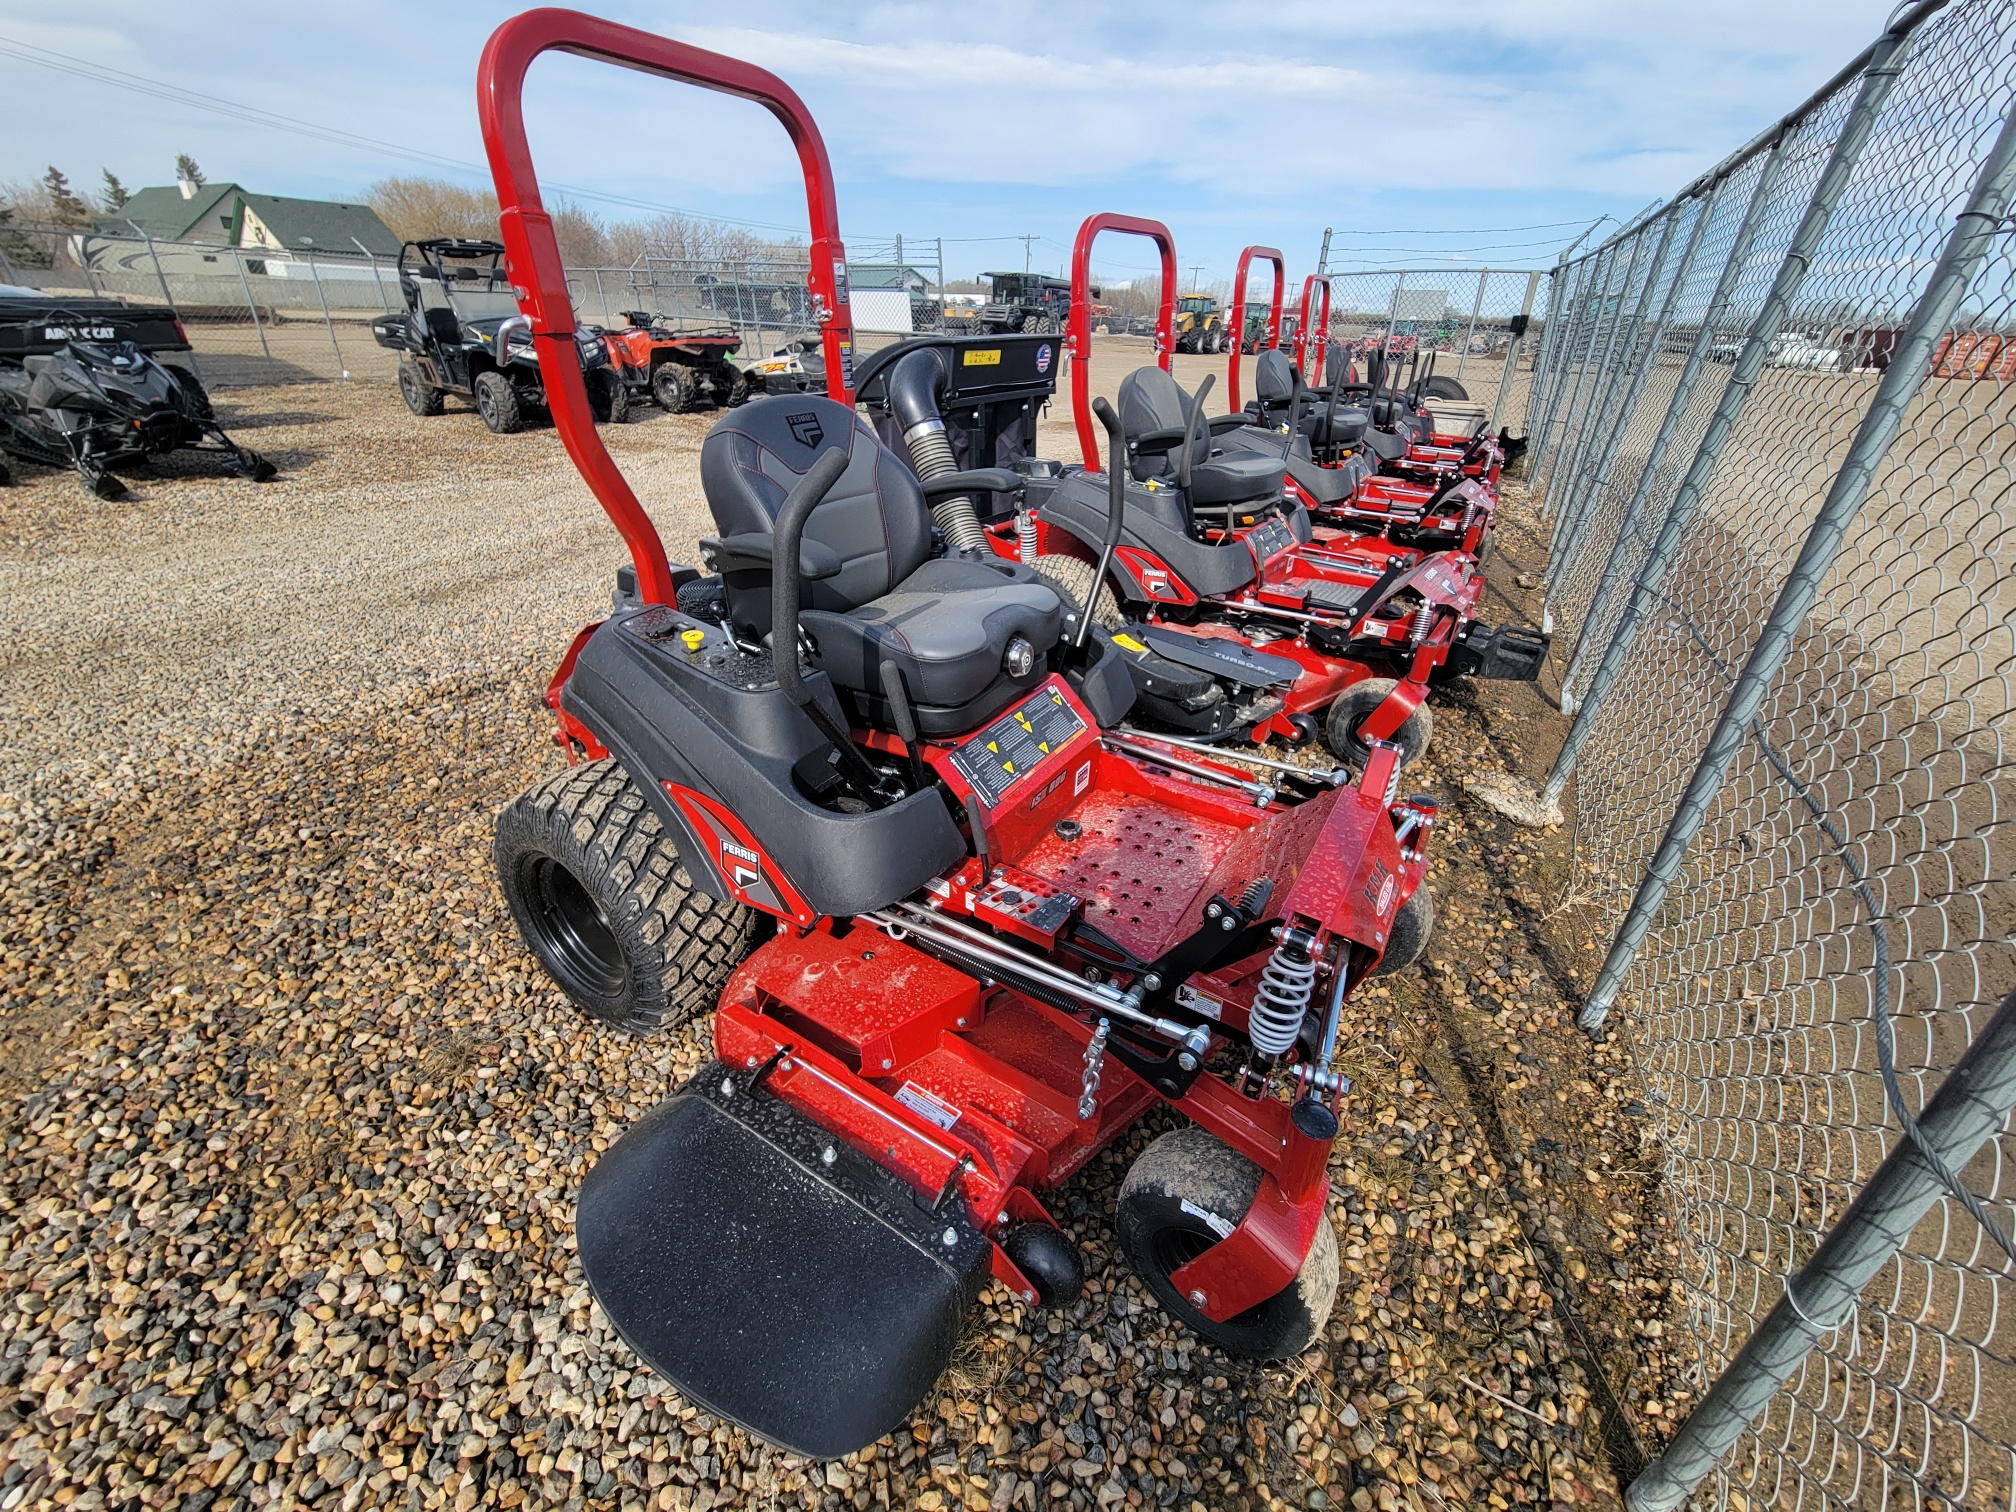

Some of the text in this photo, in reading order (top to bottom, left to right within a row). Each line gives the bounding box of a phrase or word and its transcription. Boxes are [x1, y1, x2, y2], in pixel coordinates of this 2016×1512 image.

[92, 327, 116, 339] CAT
[789, 414, 815, 424] FERRIS
[1144, 570, 1166, 578] FERRIS
[722, 841, 758, 863] FERRIS
[1364, 857, 1388, 908] KMK
[1379, 889, 1389, 909] SALES
